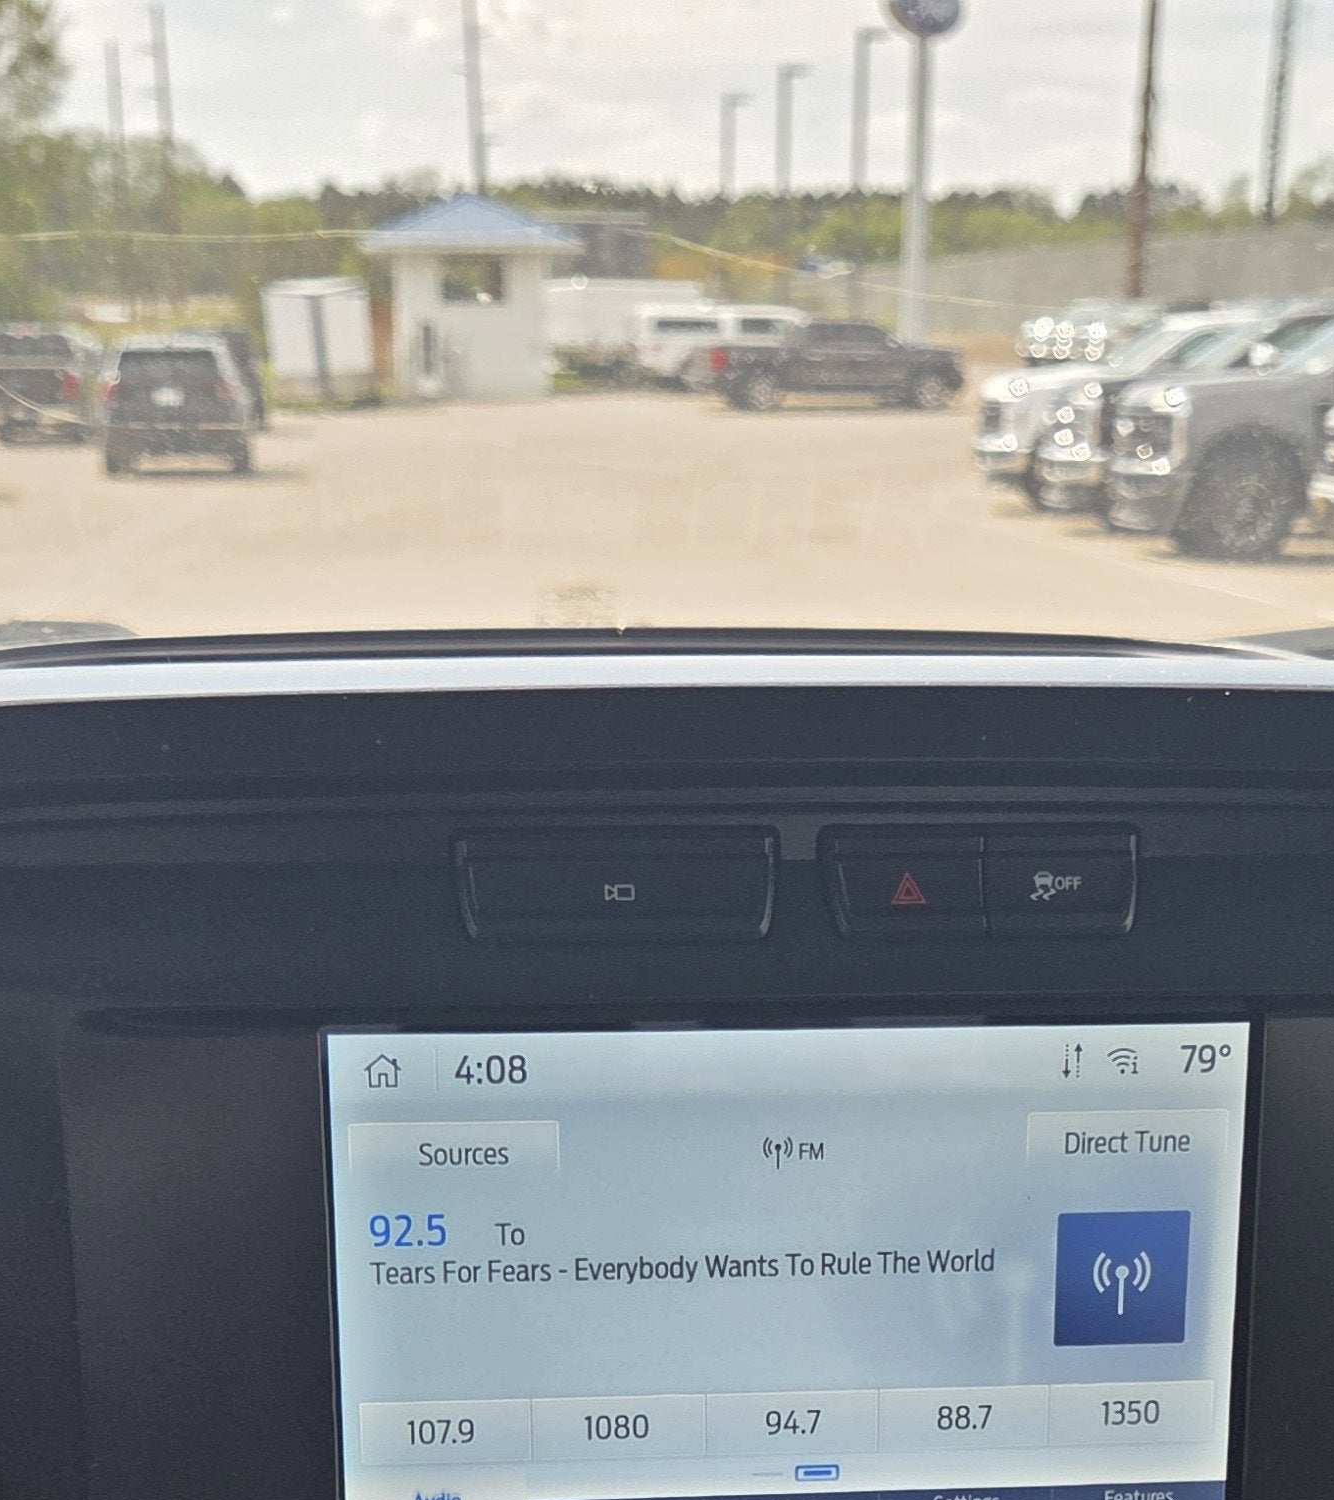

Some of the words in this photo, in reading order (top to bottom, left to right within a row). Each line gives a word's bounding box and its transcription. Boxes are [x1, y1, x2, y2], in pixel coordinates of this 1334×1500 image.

[1054, 876, 1082, 890] OFF
[454, 1054, 528, 1085] 4:08
[1179, 1043, 1232, 1074] 79°
[417, 1140, 510, 1168] Sources
[798, 1141, 826, 1162] FM
[1063, 1130, 1128, 1155] Direct
[1134, 1129, 1191, 1153] Tune
[368, 1213, 448, 1248] 92.5
[494, 1222, 526, 1247] To
[370, 1261, 436, 1286] Tears
[442, 1260, 483, 1284] For
[487, 1258, 553, 1283] Fears
[574, 1255, 698, 1283] Everybody
[704, 1253, 780, 1278] Wants
[785, 1252, 815, 1277] To
[820, 1251, 872, 1276] Rule
[878, 1249, 921, 1274] The
[927, 1247, 996, 1273] World
[584, 1413, 650, 1441] 1080
[764, 1408, 822, 1436] 94.7
[935, 1405, 993, 1433] 88.7
[1099, 1399, 1161, 1427] 1350
[406, 1416, 476, 1446] 107.9
